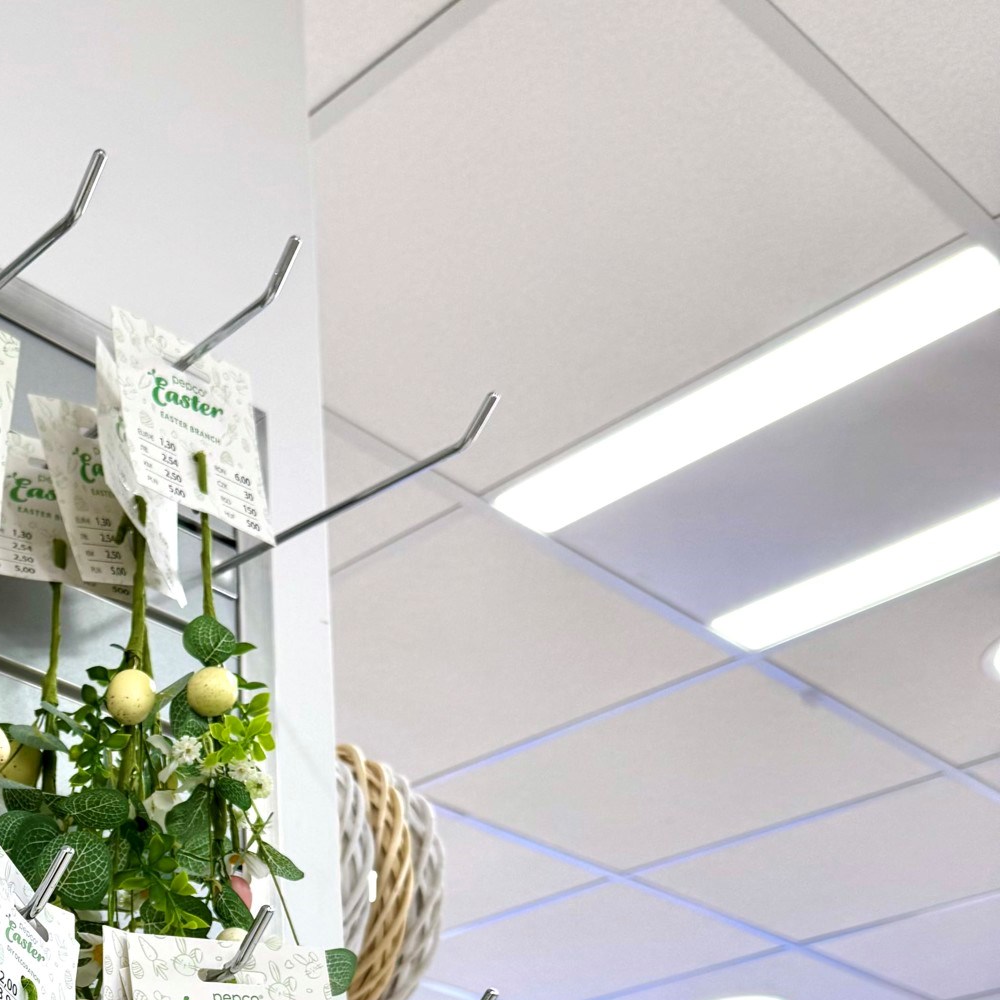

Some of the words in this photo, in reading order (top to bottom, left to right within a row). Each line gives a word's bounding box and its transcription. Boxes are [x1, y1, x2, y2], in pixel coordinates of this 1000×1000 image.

[147, 369, 224, 418] Easter
[160, 411, 189, 432] EASTER
[5, 913, 45, 963] Easter
[0, 970, 18, 996] 2,00
